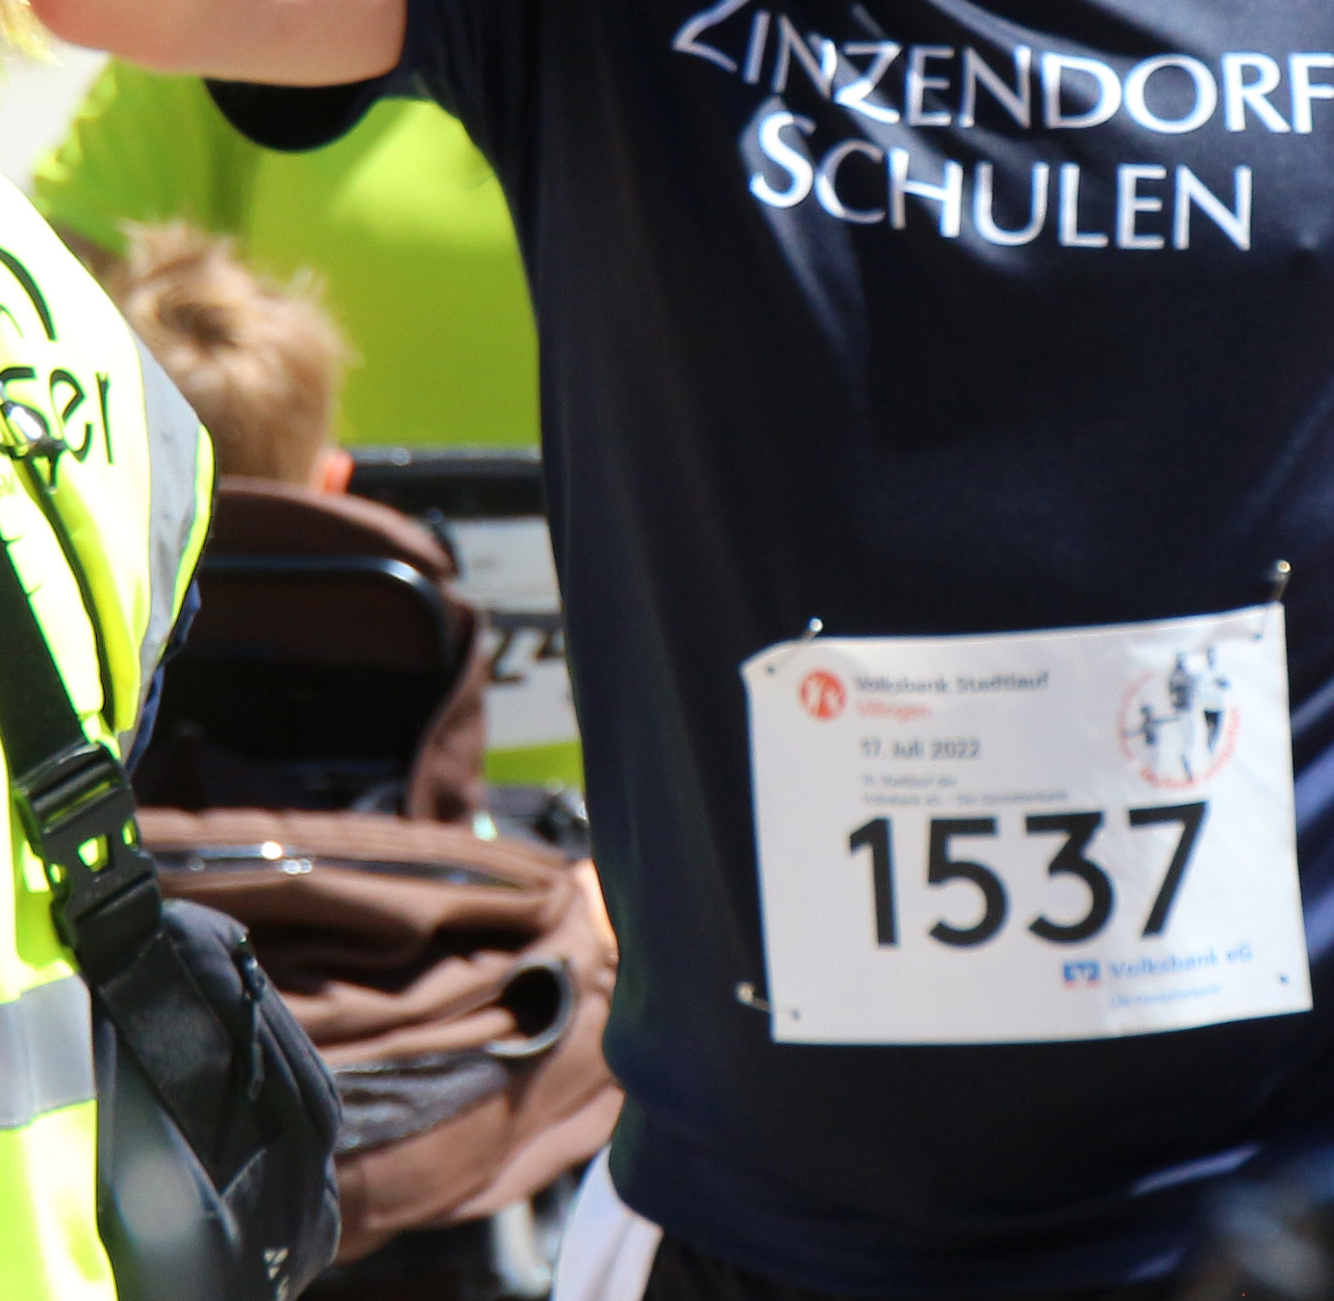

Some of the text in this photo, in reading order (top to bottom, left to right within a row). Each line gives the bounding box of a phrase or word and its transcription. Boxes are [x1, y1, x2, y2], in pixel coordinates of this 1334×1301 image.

[750, 111, 1253, 251] SCHULEN
[857, 669, 1050, 694] Volksbank Stadtlauf
[892, 737, 925, 760] Juli
[931, 737, 981, 760] 2022
[848, 801, 1208, 948] 1537
[1109, 948, 1218, 981] Volksbank
